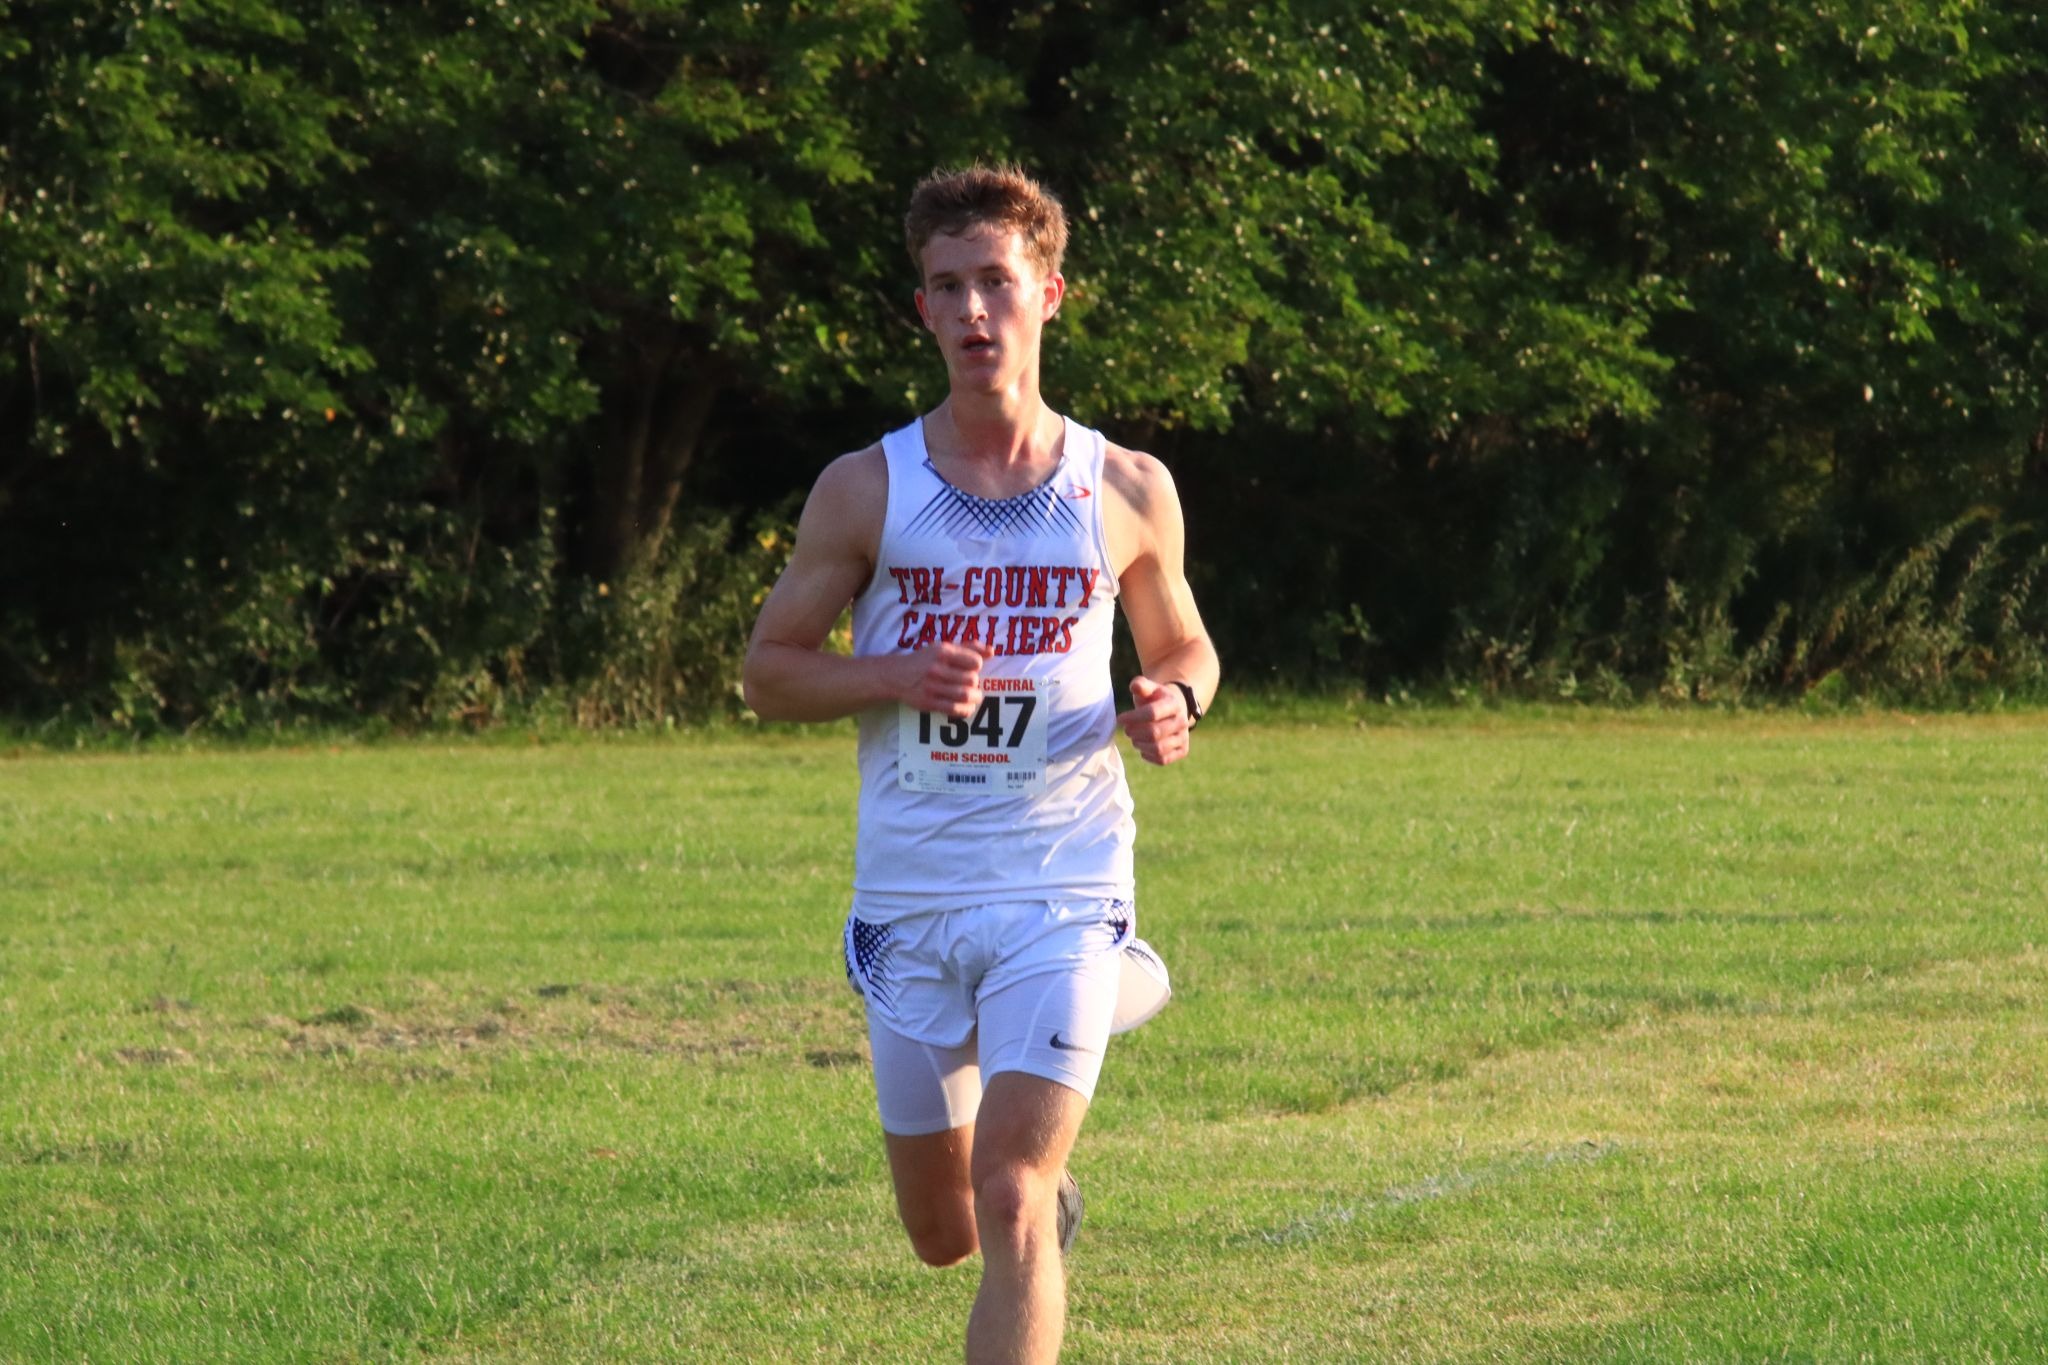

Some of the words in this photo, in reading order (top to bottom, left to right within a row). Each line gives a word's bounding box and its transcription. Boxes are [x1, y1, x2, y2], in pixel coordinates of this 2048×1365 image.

[889, 566, 1100, 608] TRI-COUNTY
[897, 611, 1079, 656] CAVALIERS
[983, 678, 1035, 691] CENTRAL
[919, 695, 1037, 748] 1347
[931, 751, 958, 762] HIGH
[961, 752, 1010, 763] SCHOOL
